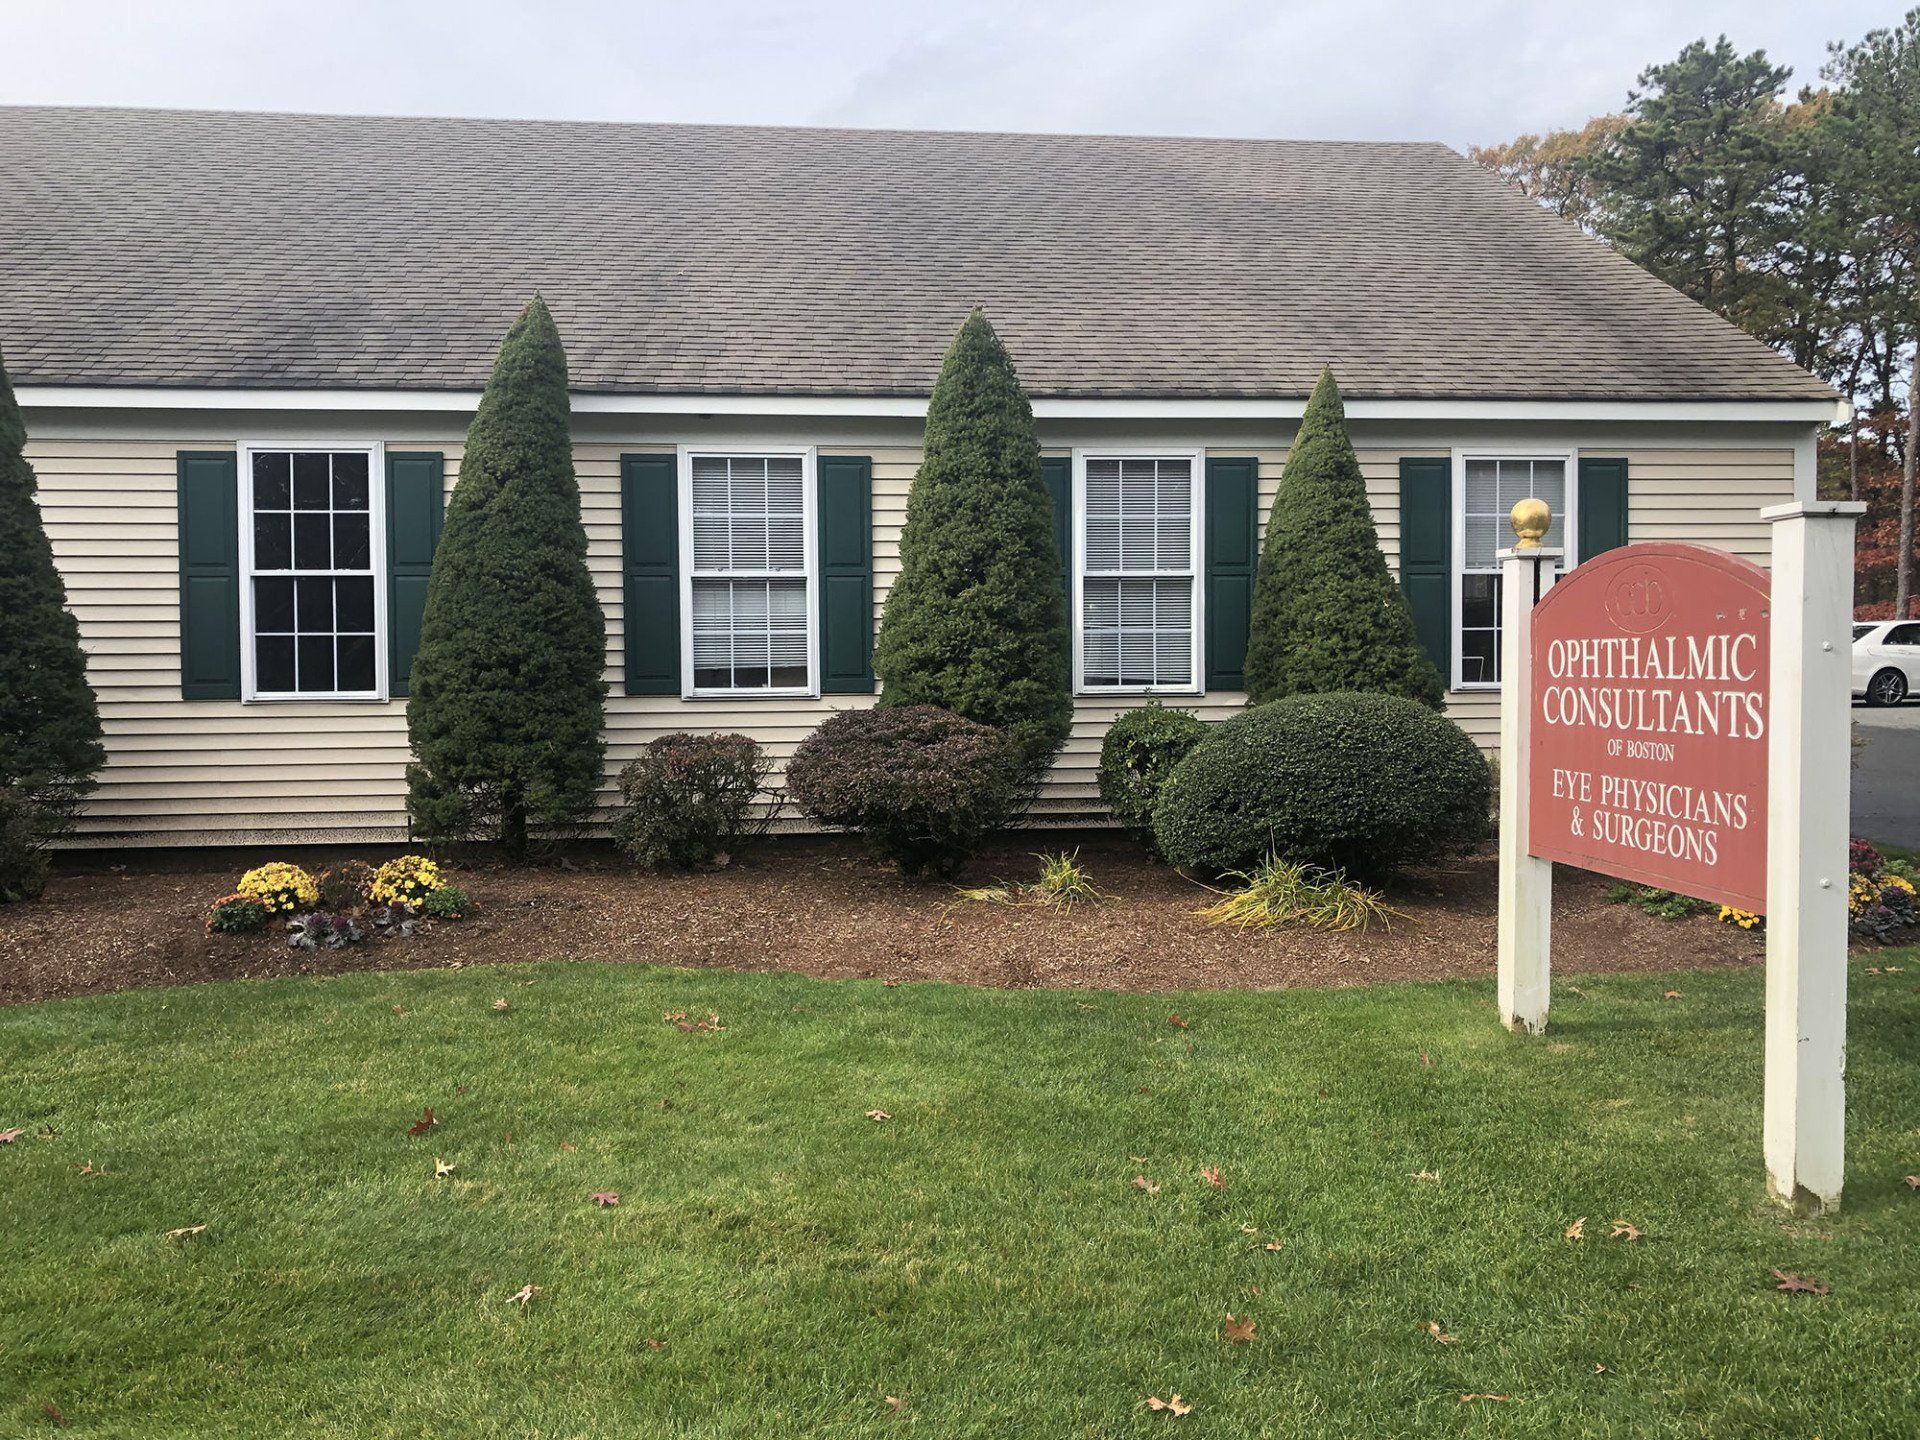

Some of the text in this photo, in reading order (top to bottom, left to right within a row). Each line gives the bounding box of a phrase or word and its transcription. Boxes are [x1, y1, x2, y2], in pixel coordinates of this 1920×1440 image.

[1547, 633, 1757, 682] OPHTHALMIC
[1542, 685, 1765, 740] CONSULTANTS
[1607, 738, 1675, 762] OF BOSTON
[1552, 768, 1748, 830] EYE PHYSICIANS
[1570, 805, 1718, 866] & SURGEONS
